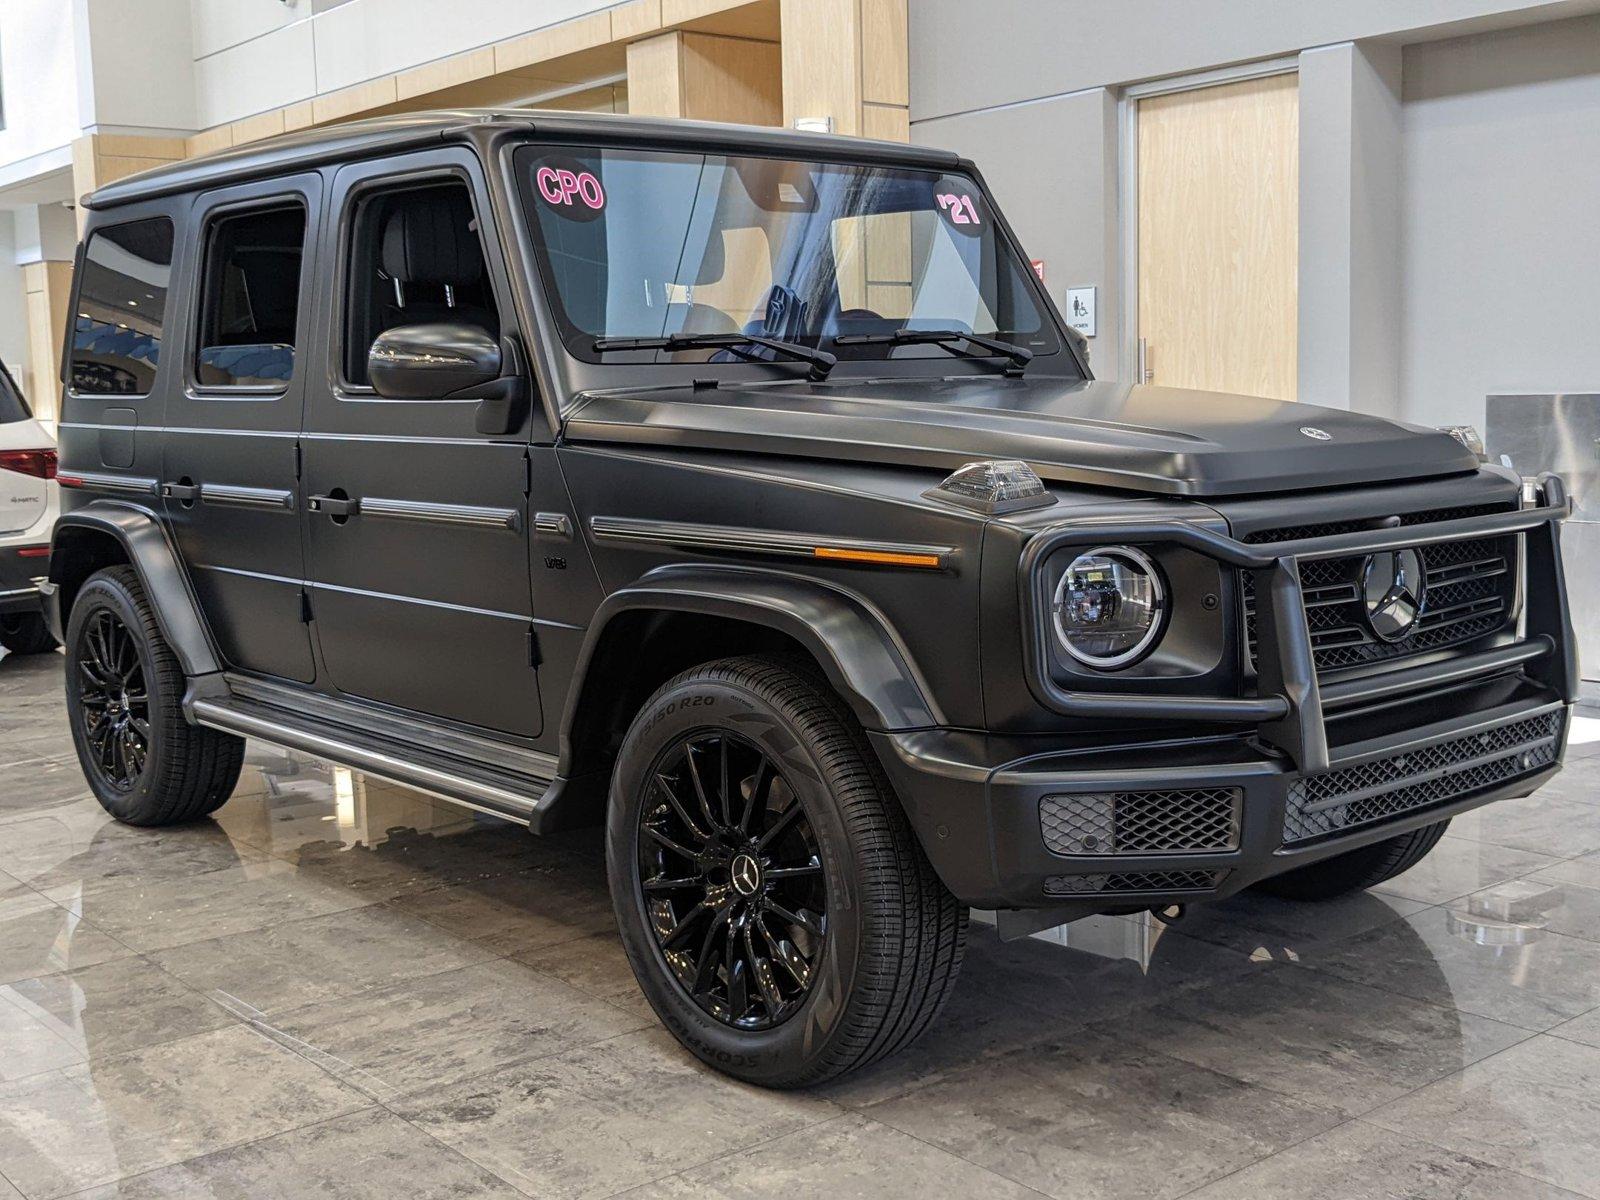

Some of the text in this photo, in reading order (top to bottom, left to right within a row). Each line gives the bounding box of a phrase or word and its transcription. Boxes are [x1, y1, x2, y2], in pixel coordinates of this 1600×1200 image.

[536, 167, 604, 209] CPO
[936, 194, 981, 224] '21
[680, 696, 716, 709] R20
